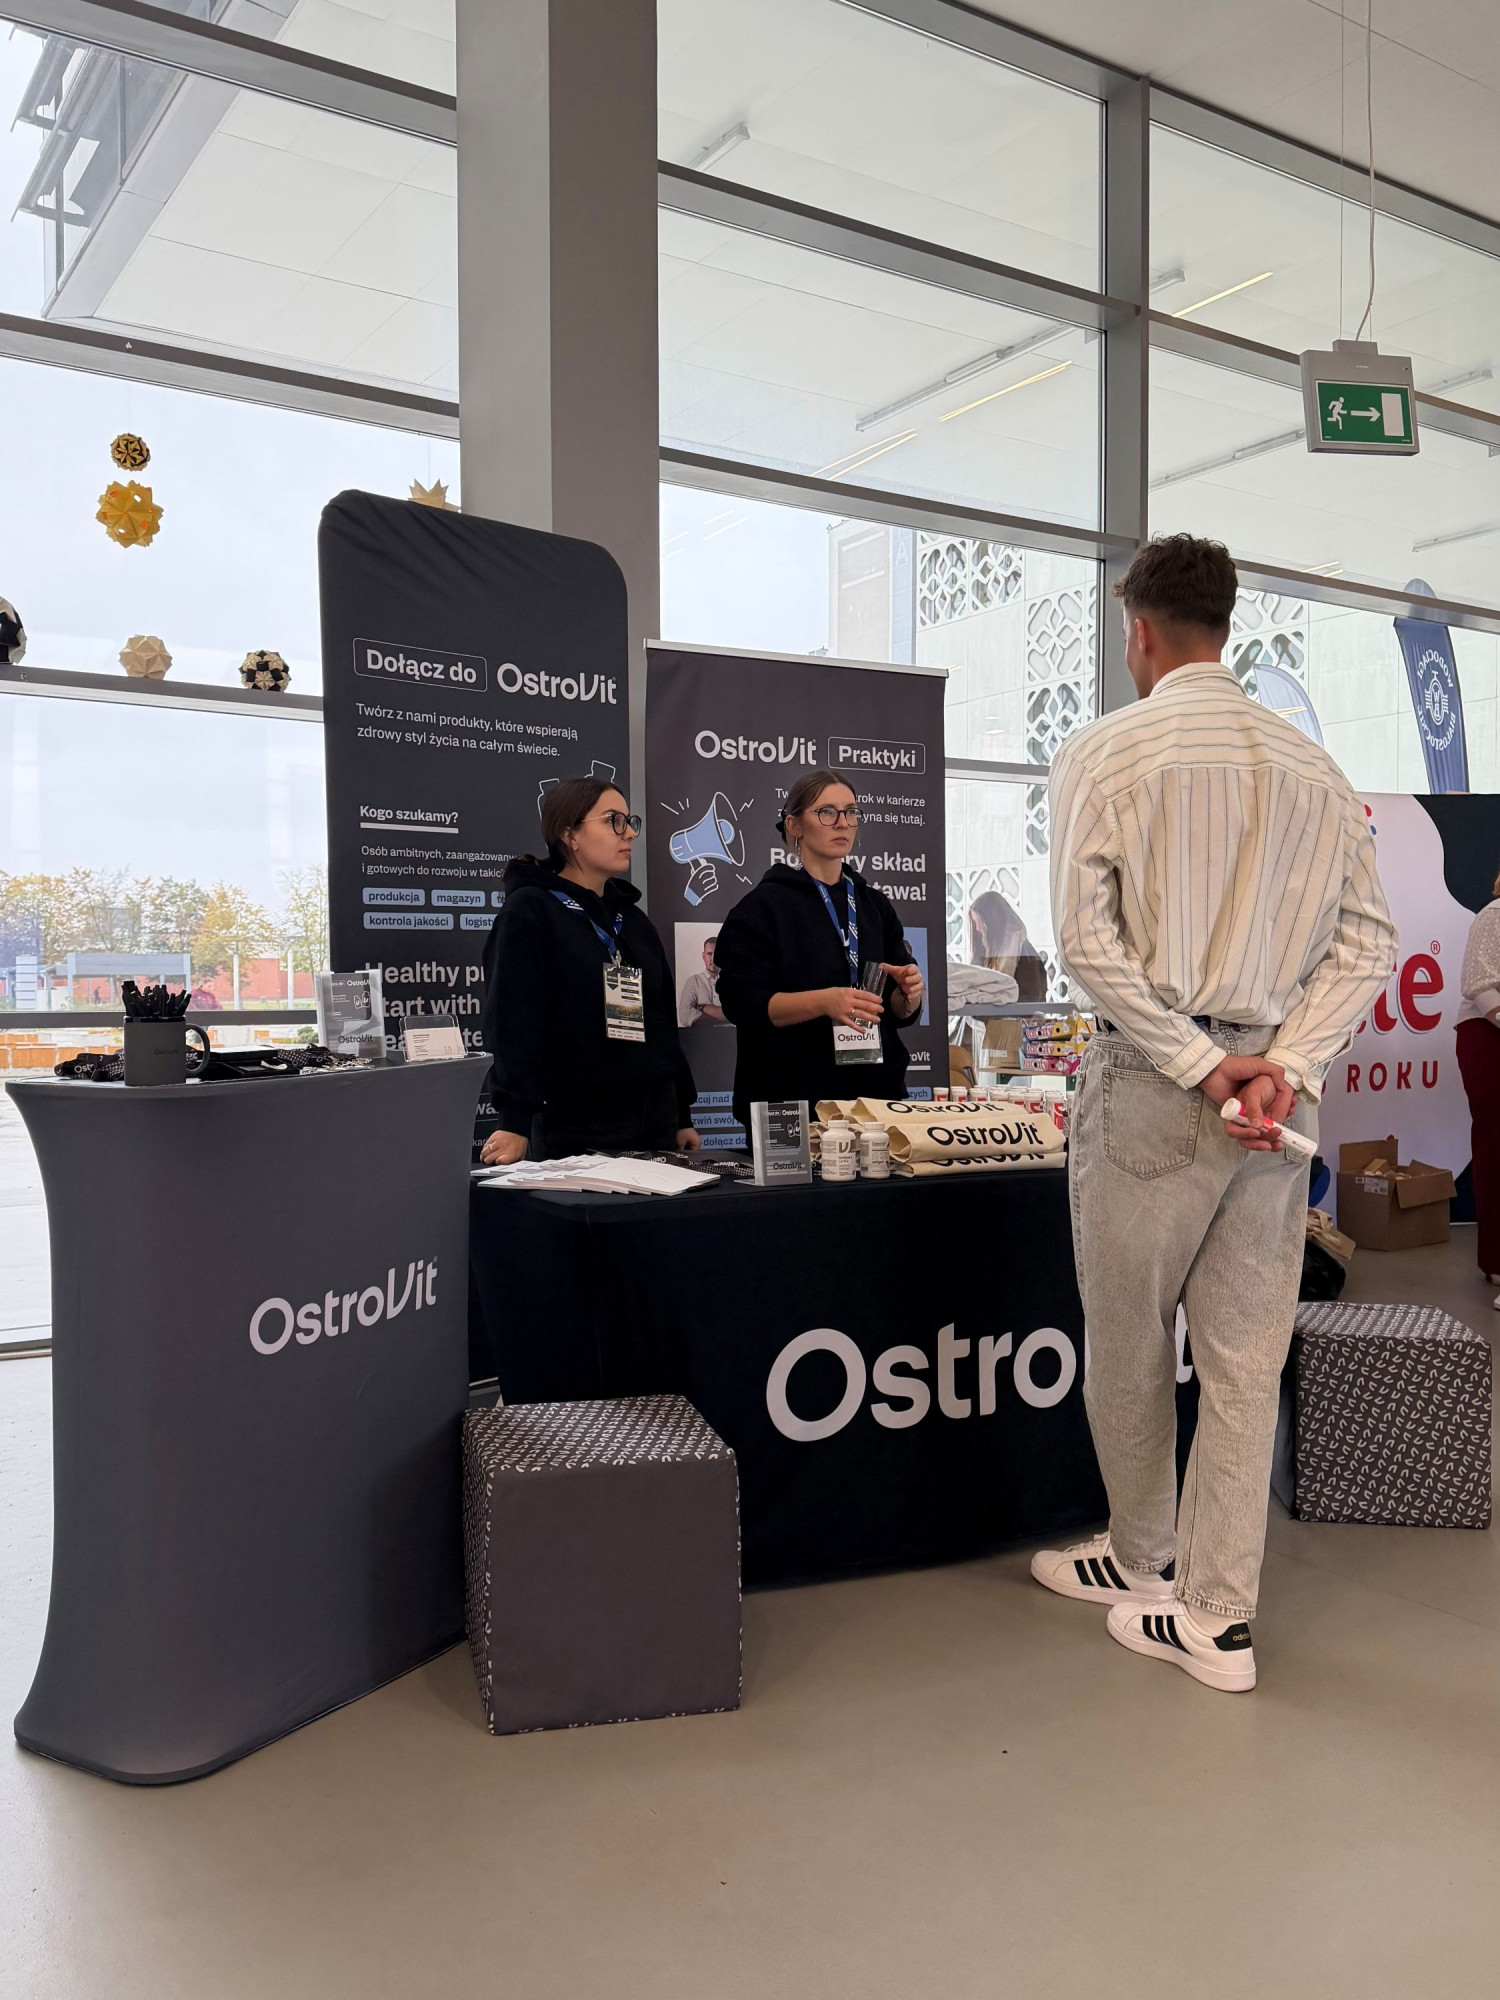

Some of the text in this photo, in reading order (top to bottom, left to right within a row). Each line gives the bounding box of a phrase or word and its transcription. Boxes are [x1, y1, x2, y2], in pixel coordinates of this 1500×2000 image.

[366, 649, 477, 684] Dołącz do
[497, 662, 617, 704] OstroVit
[356, 702, 578, 741] Twórz z nami produkty, które wspierają
[357, 725, 560, 757] zdrowy styl życia na całym świecie.
[695, 730, 817, 765] OstroVit
[838, 745, 916, 770] Praktyki
[856, 793, 873, 804] rok
[887, 796, 925, 807] karierze
[360, 805, 459, 824] Kogo szukamy?
[885, 813, 899, 824] się
[900, 814, 925, 826] tutaj.
[361, 845, 388, 856] Osób
[390, 848, 444, 860] ambitnych,
[872, 851, 926, 873] skład
[367, 865, 415, 876] gotowych
[417, 866, 429, 875] do
[431, 867, 468, 878] rozwoju
[368, 891, 420, 904] produkcja
[437, 894, 481, 905] magazyn
[369, 915, 449, 928] kontrola jakości
[383, 994, 481, 1017] tart with
[837, 1033, 875, 1042] OstroVit
[1347, 1060, 1439, 1093] ROKU
[712, 1095, 730, 1103] nad
[703, 1137, 734, 1147] dołącz
[927, 1122, 1043, 1146] OstroVit
[249, 1259, 437, 1355] OstroVit
